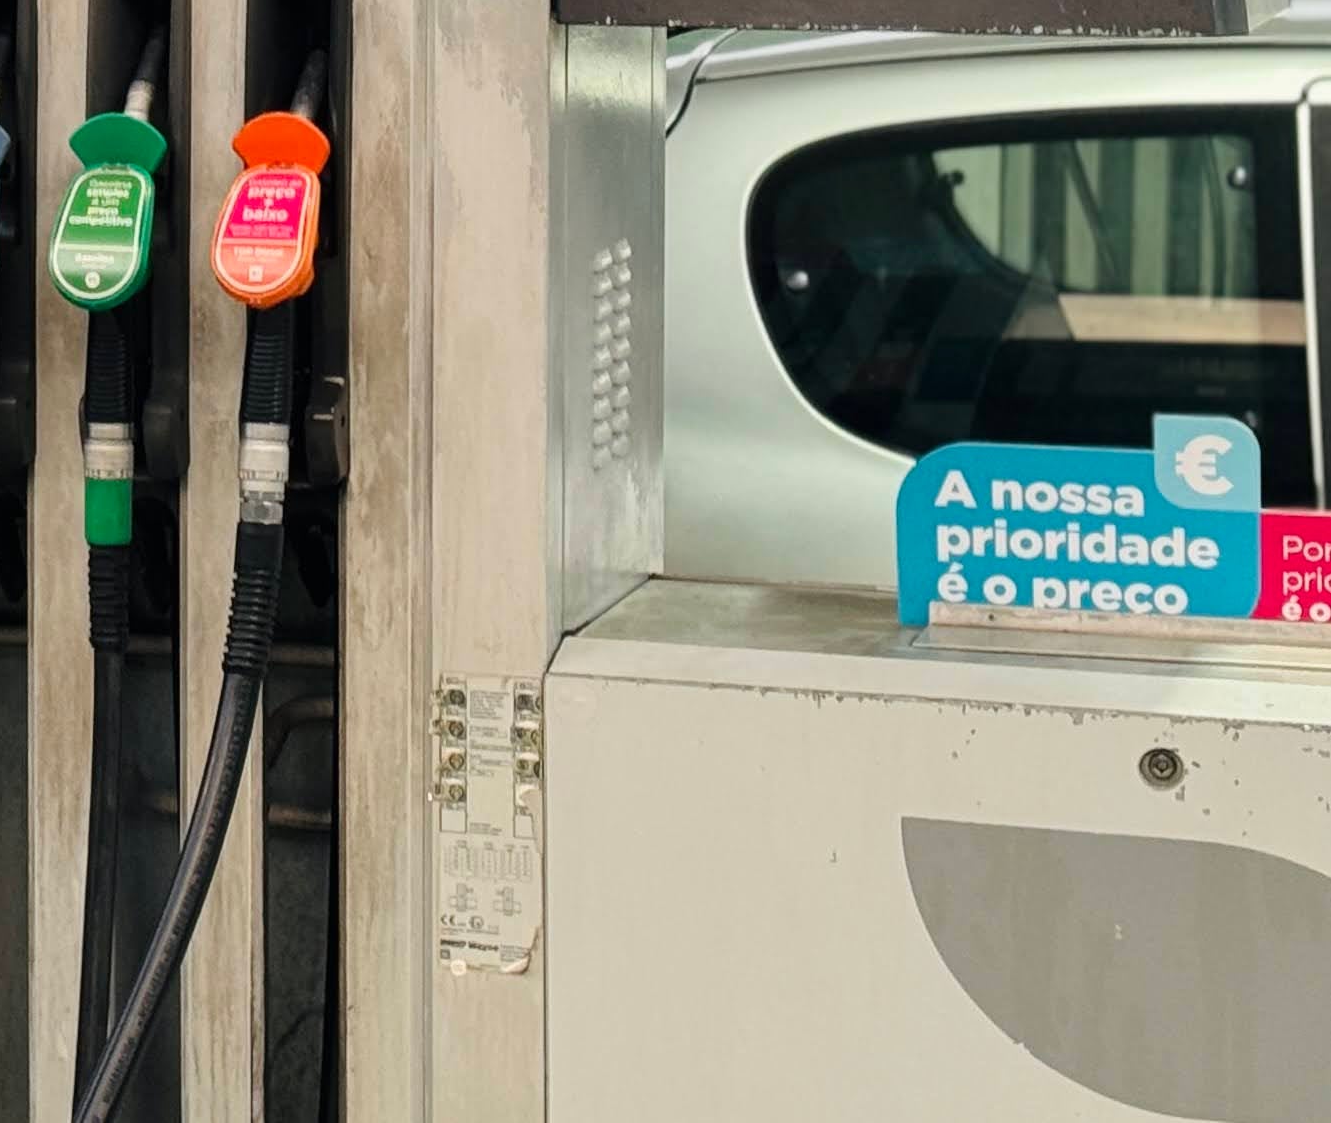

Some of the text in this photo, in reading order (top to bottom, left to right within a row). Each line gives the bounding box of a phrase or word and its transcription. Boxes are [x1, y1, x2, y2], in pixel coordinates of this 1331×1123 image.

[242, 205, 289, 221] baixo
[247, 187, 296, 200] preço
[1174, 434, 1234, 495] €
[934, 469, 1145, 518] A nossa
[937, 518, 1220, 568] prioridade
[937, 562, 968, 603] é
[982, 574, 1018, 605] o
[1281, 594, 1331, 623] é o
